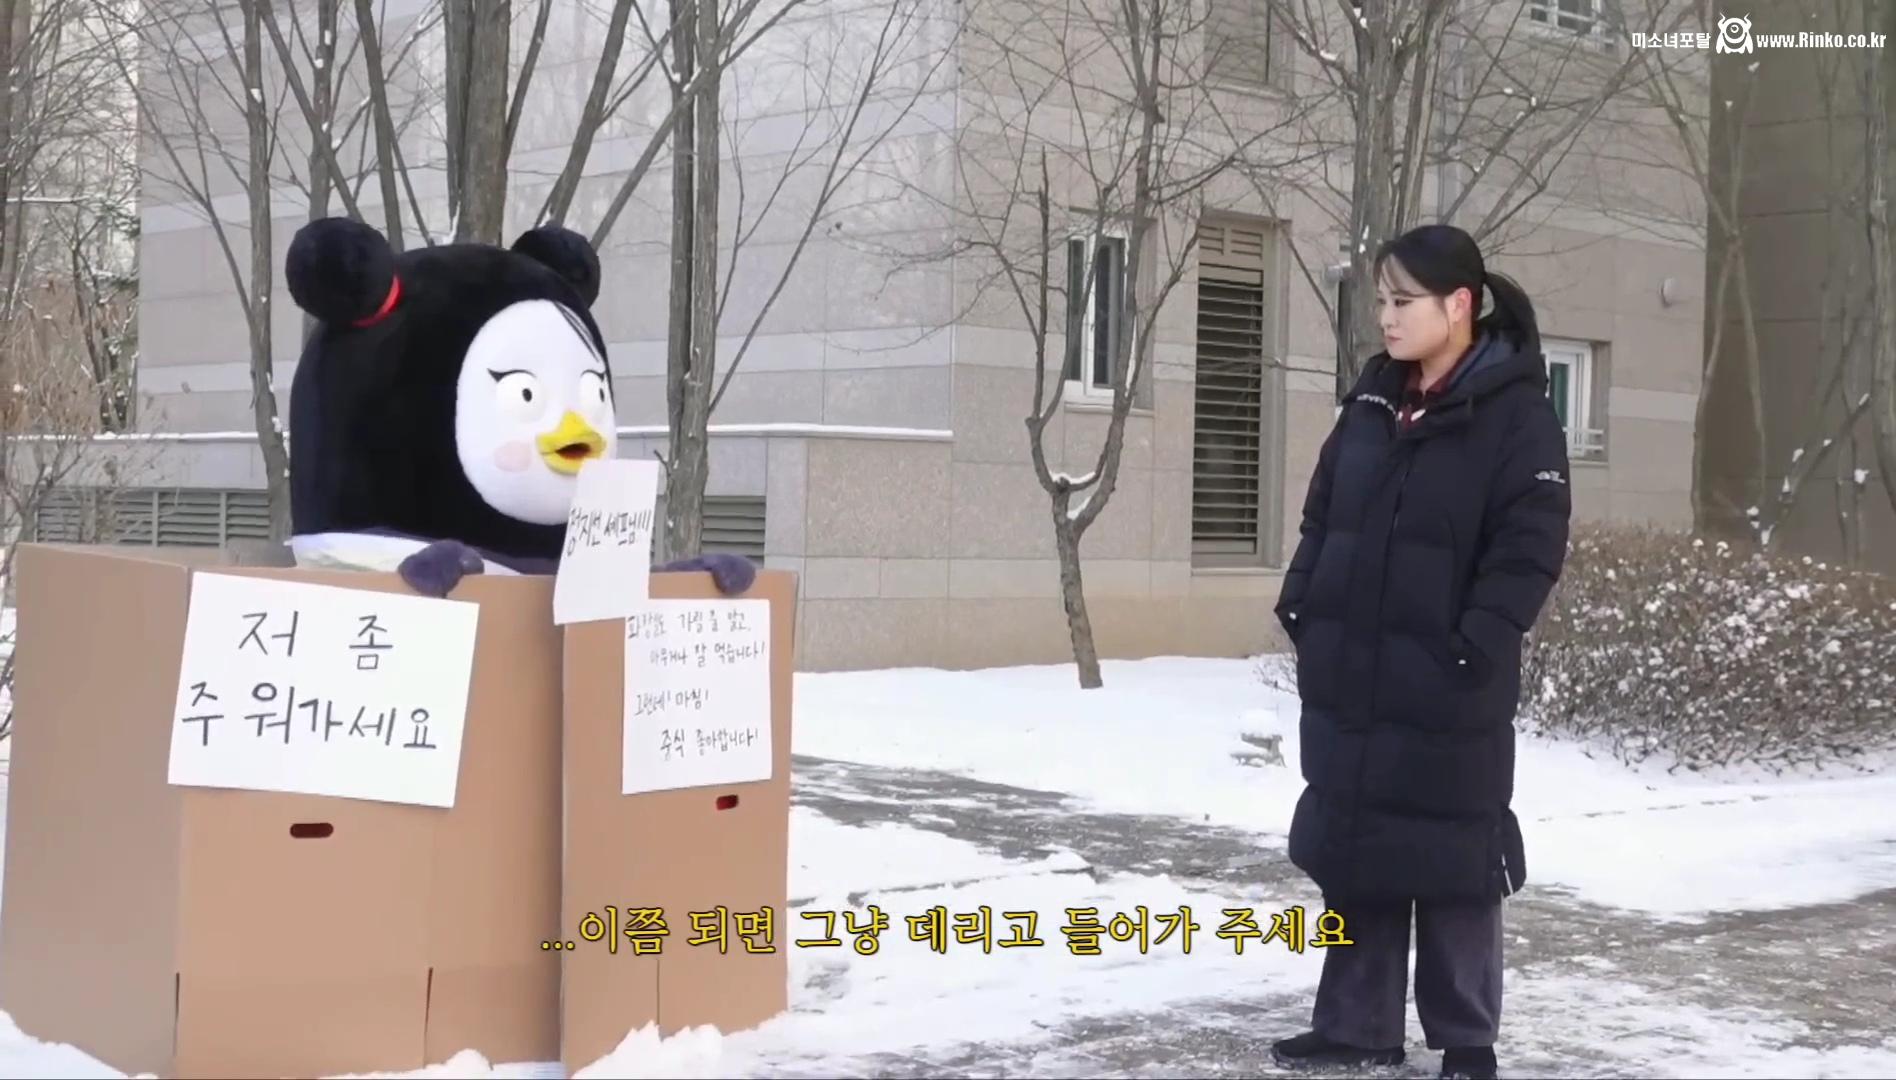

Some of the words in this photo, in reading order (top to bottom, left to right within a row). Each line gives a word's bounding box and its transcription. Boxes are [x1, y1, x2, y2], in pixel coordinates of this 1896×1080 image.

[238, 610, 299, 657] 저
[349, 615, 393, 670] 좀
[694, 642, 707, 668] 잘
